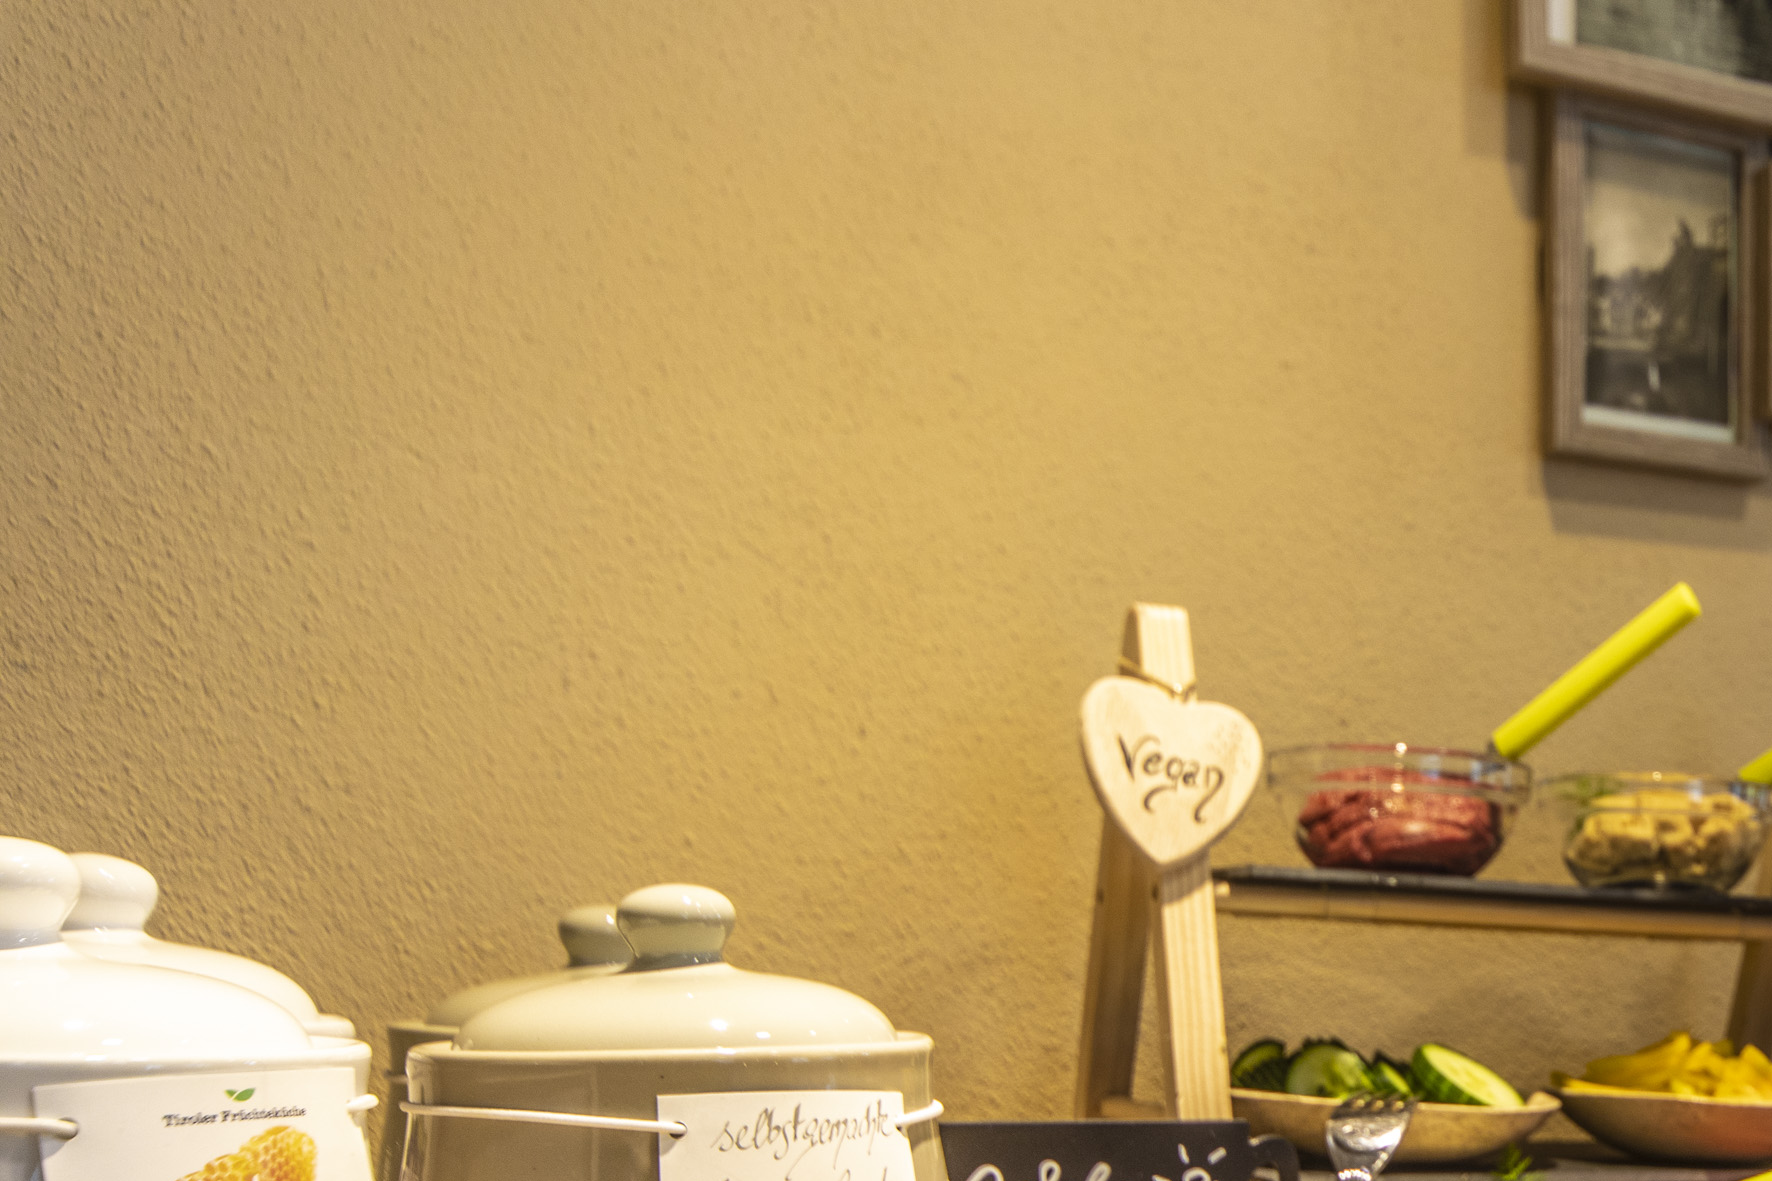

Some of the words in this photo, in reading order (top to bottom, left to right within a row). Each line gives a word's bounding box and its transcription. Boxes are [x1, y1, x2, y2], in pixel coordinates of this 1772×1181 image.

[1117, 735, 1226, 824] Vegan
[161, 1111, 219, 1128] Tiroler
[711, 1099, 895, 1181] selbstgemachte
